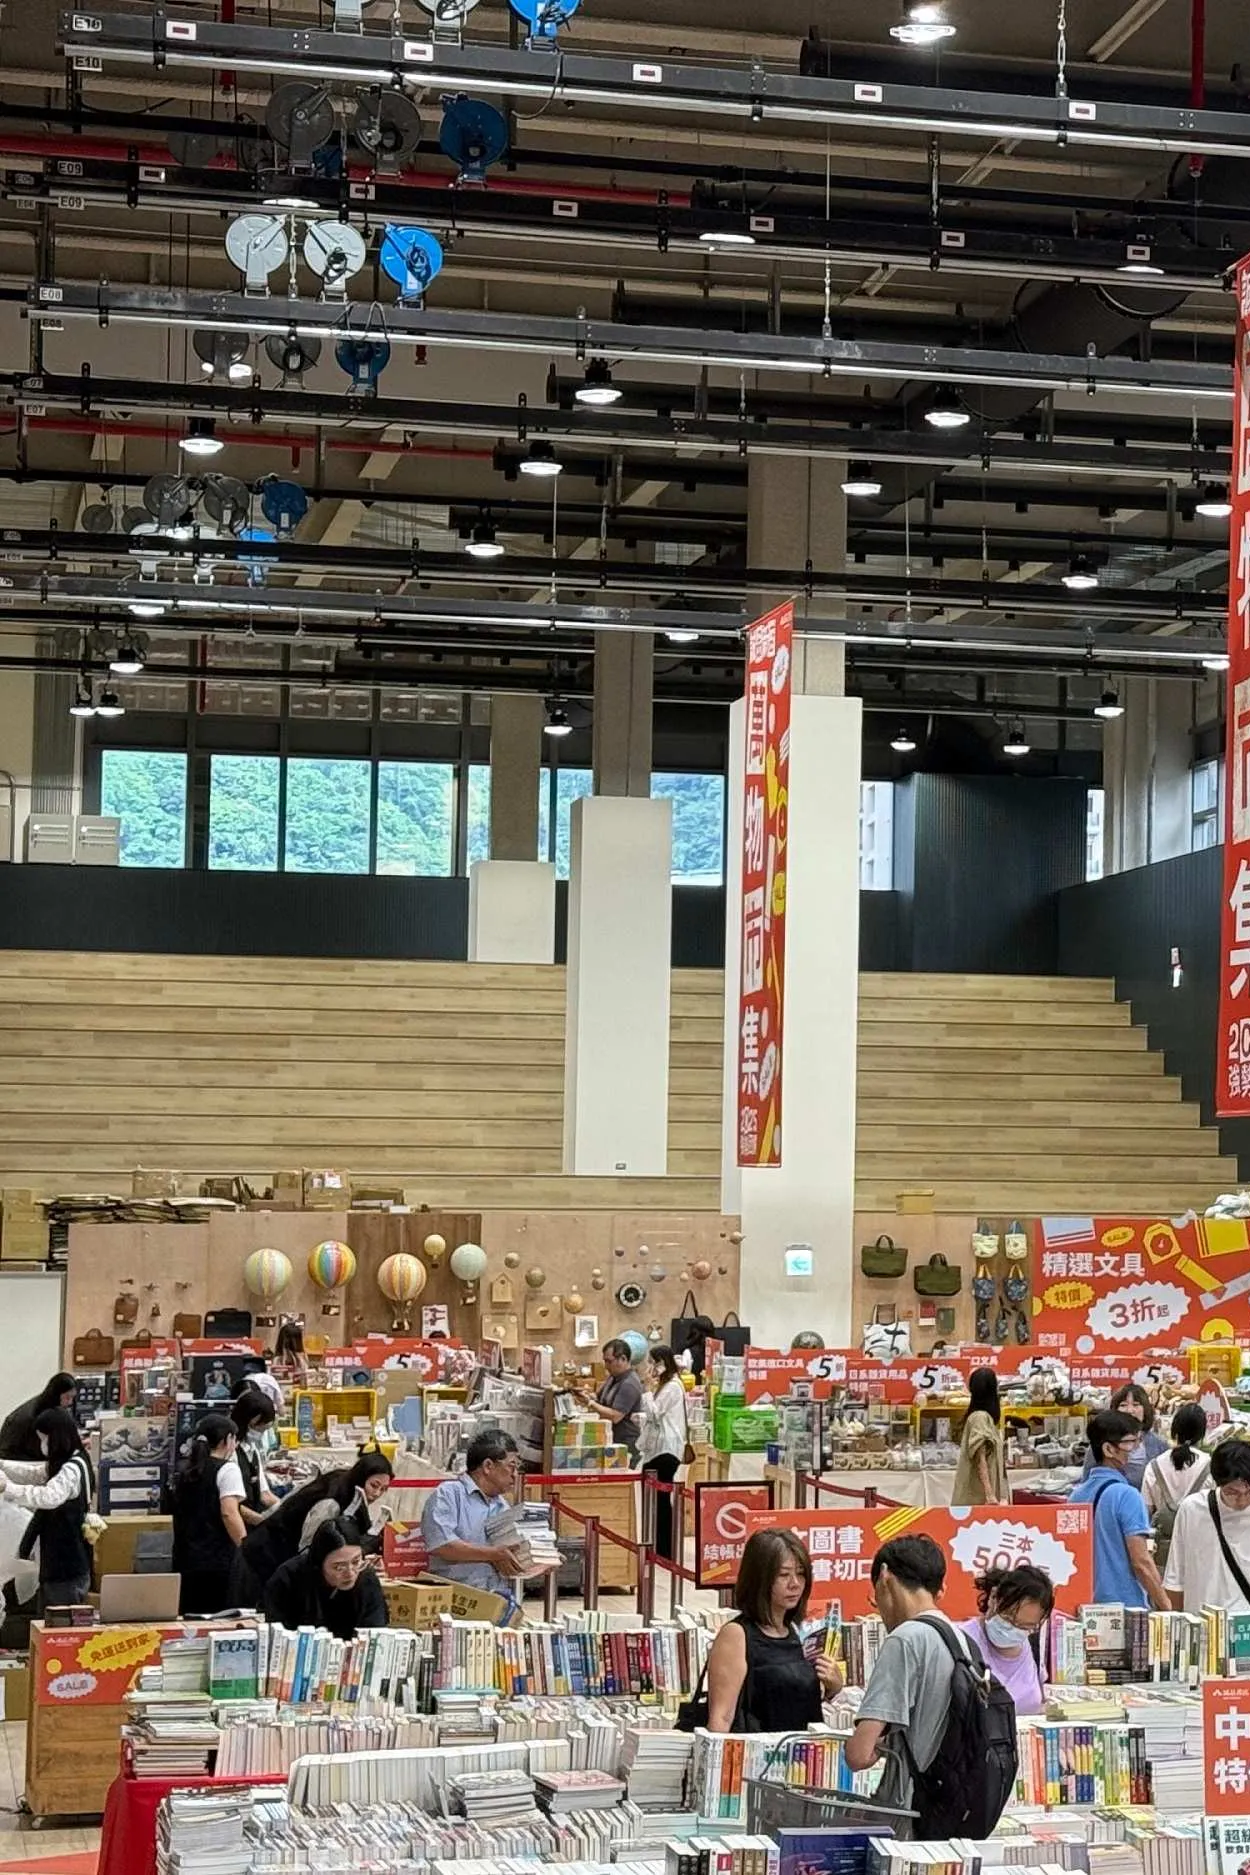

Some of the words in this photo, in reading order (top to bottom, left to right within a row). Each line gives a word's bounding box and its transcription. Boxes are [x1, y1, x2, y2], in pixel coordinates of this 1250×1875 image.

[75, 17, 100, 30] E10
[76, 57, 100, 69] E10
[59, 161, 82, 174] E09
[61, 196, 82, 207] E09
[41, 288, 61, 299] E08
[741, 670, 768, 1095] 萬物市集
[1042, 1252, 1146, 1278] 精選文具
[998, 1532, 1035, 1553] 三本
[56, 1680, 89, 1692] SALE
